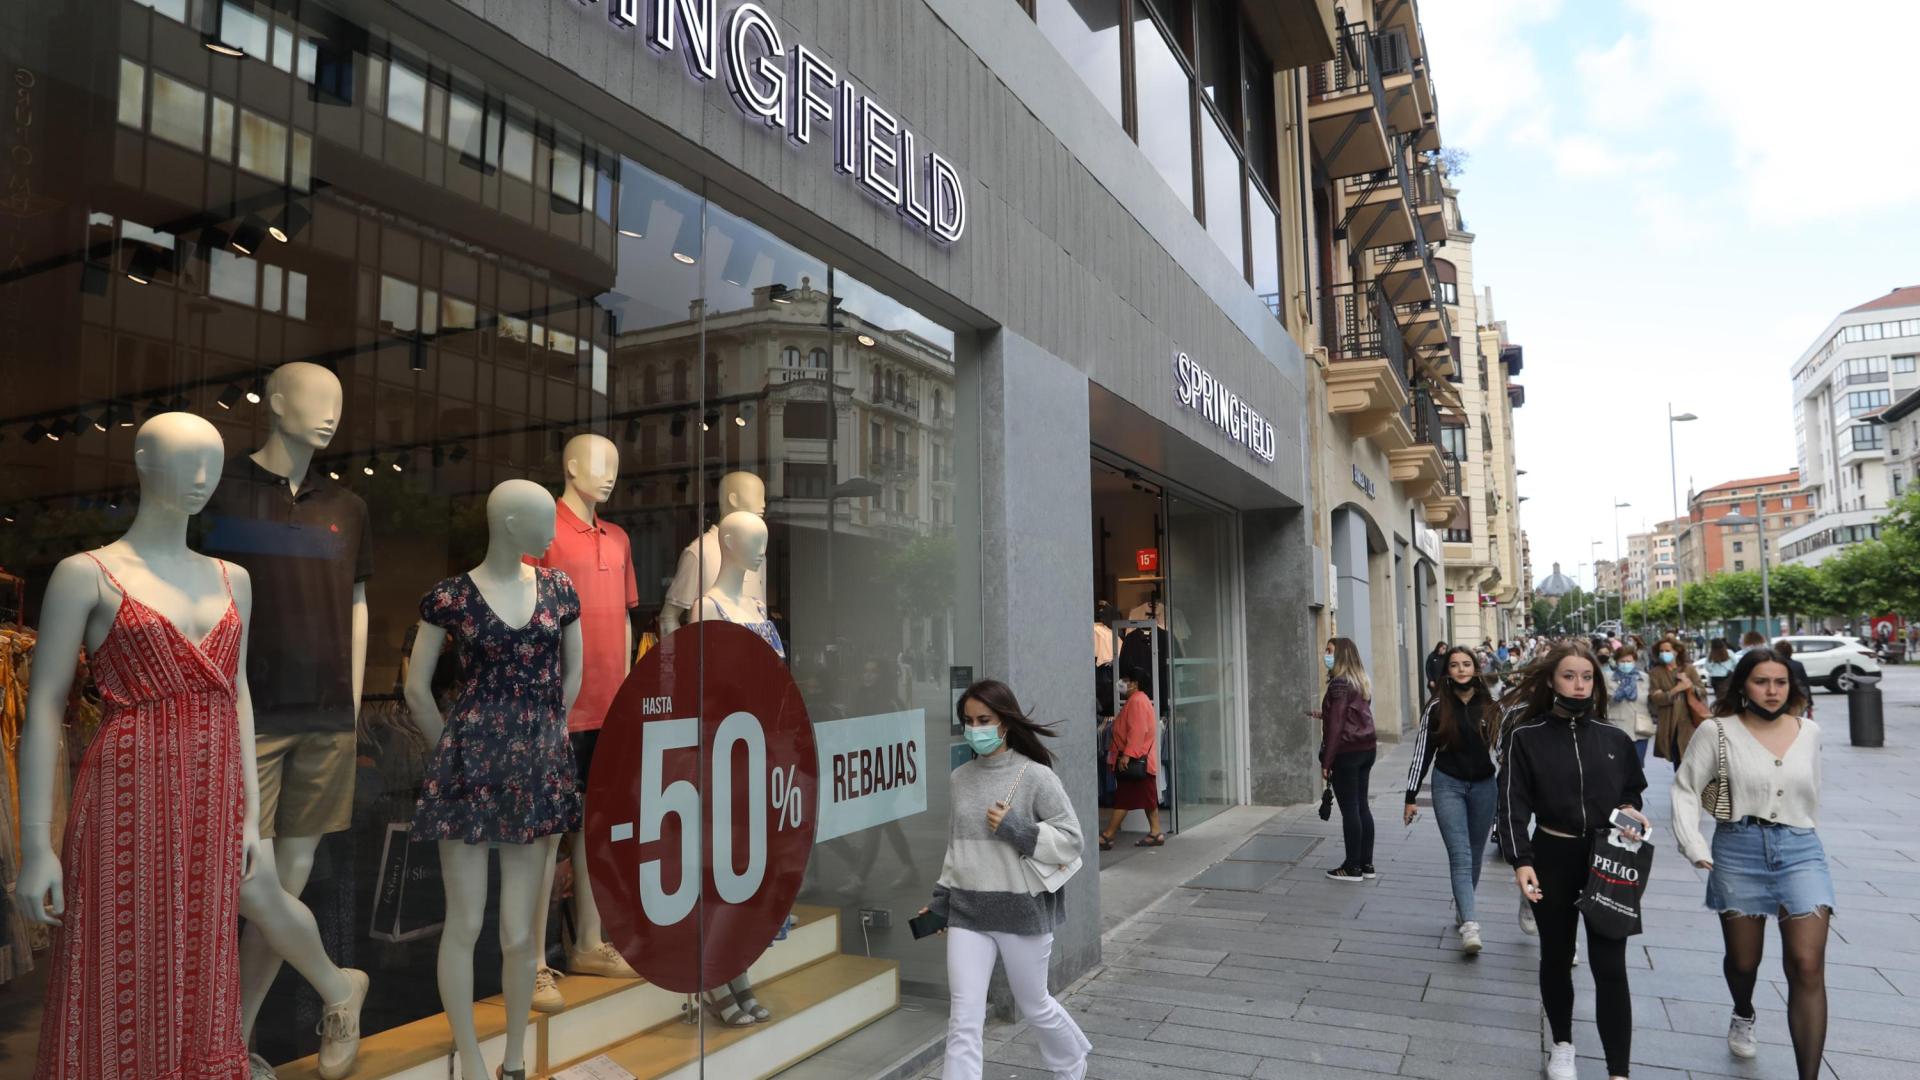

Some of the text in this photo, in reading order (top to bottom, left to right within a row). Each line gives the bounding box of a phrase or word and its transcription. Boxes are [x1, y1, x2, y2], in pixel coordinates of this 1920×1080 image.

[1177, 352, 1275, 462] SPRINGFIELD
[642, 696, 673, 716] HASTA
[832, 739, 917, 804] REBAJAS
